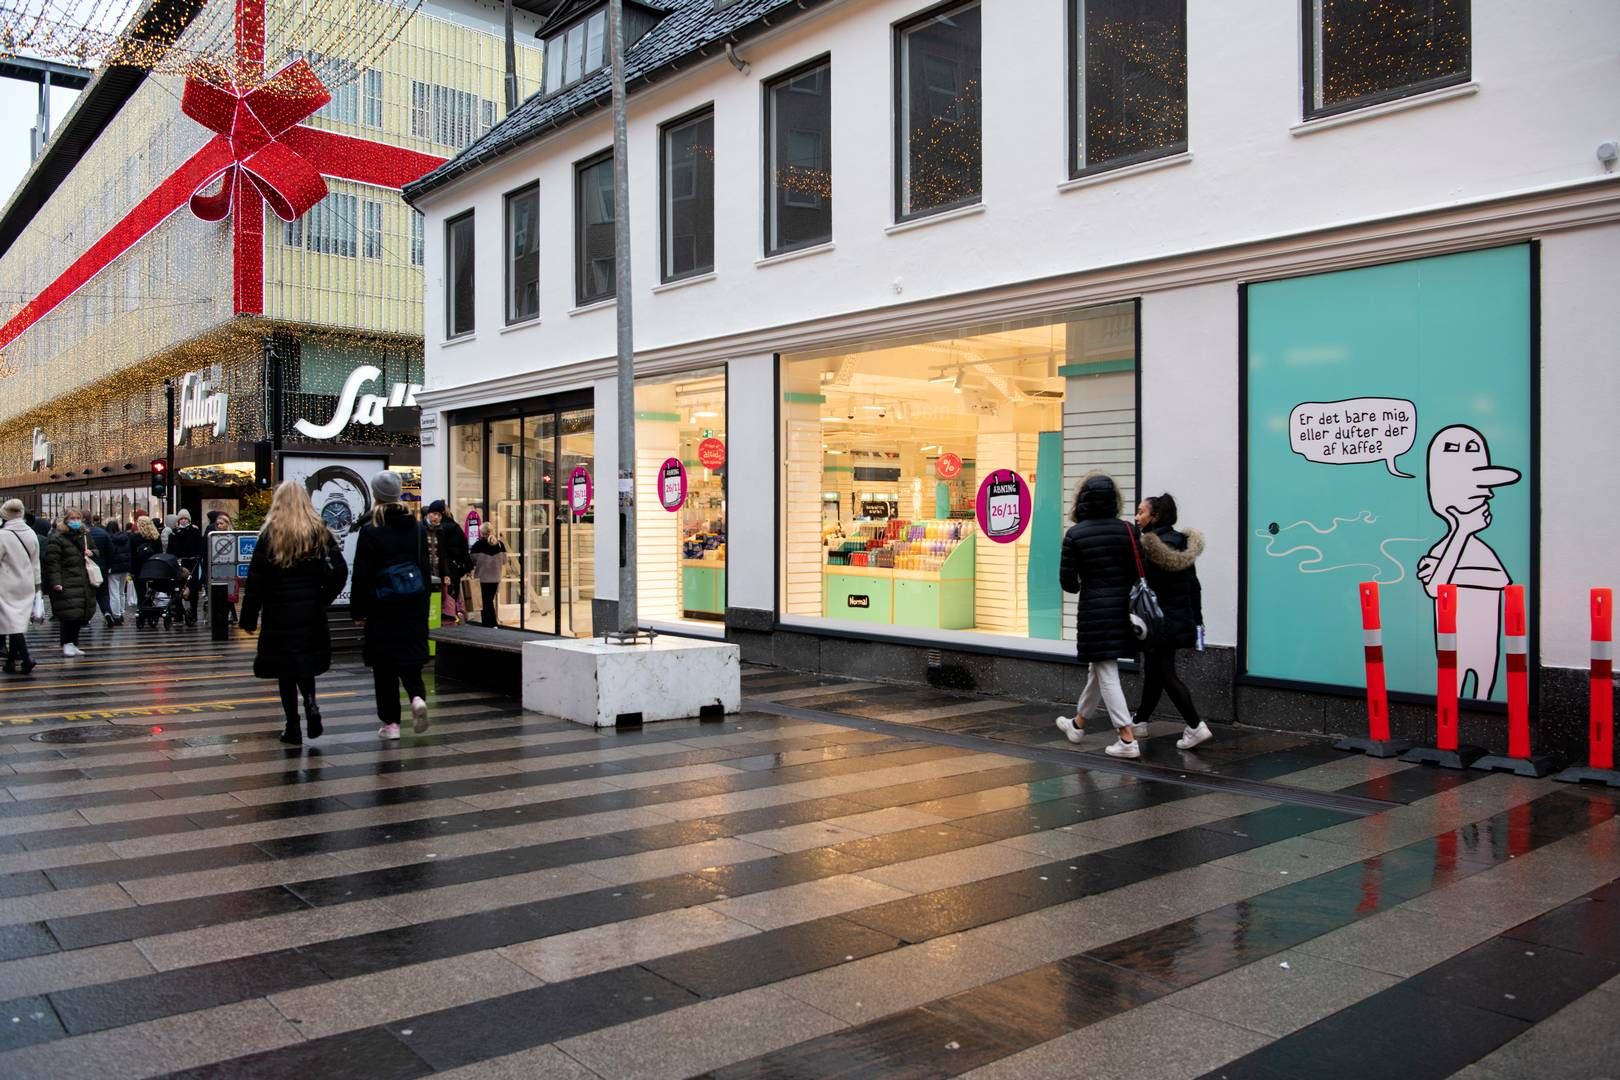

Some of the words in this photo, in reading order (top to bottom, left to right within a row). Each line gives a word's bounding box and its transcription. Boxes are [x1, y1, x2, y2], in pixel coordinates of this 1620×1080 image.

[1300, 413, 1313, 425] Er
[1319, 412, 1340, 425] det
[1345, 410, 1376, 424] bare
[1382, 408, 1409, 422] mig,
[1300, 428, 1329, 440] eller
[1335, 426, 1379, 440] dufter
[1384, 424, 1408, 437] der
[1323, 442, 1337, 456] af
[1342, 440, 1382, 455] kaffe?
[991, 503, 1018, 517] 26/11
[849, 596, 868, 606] Normal
